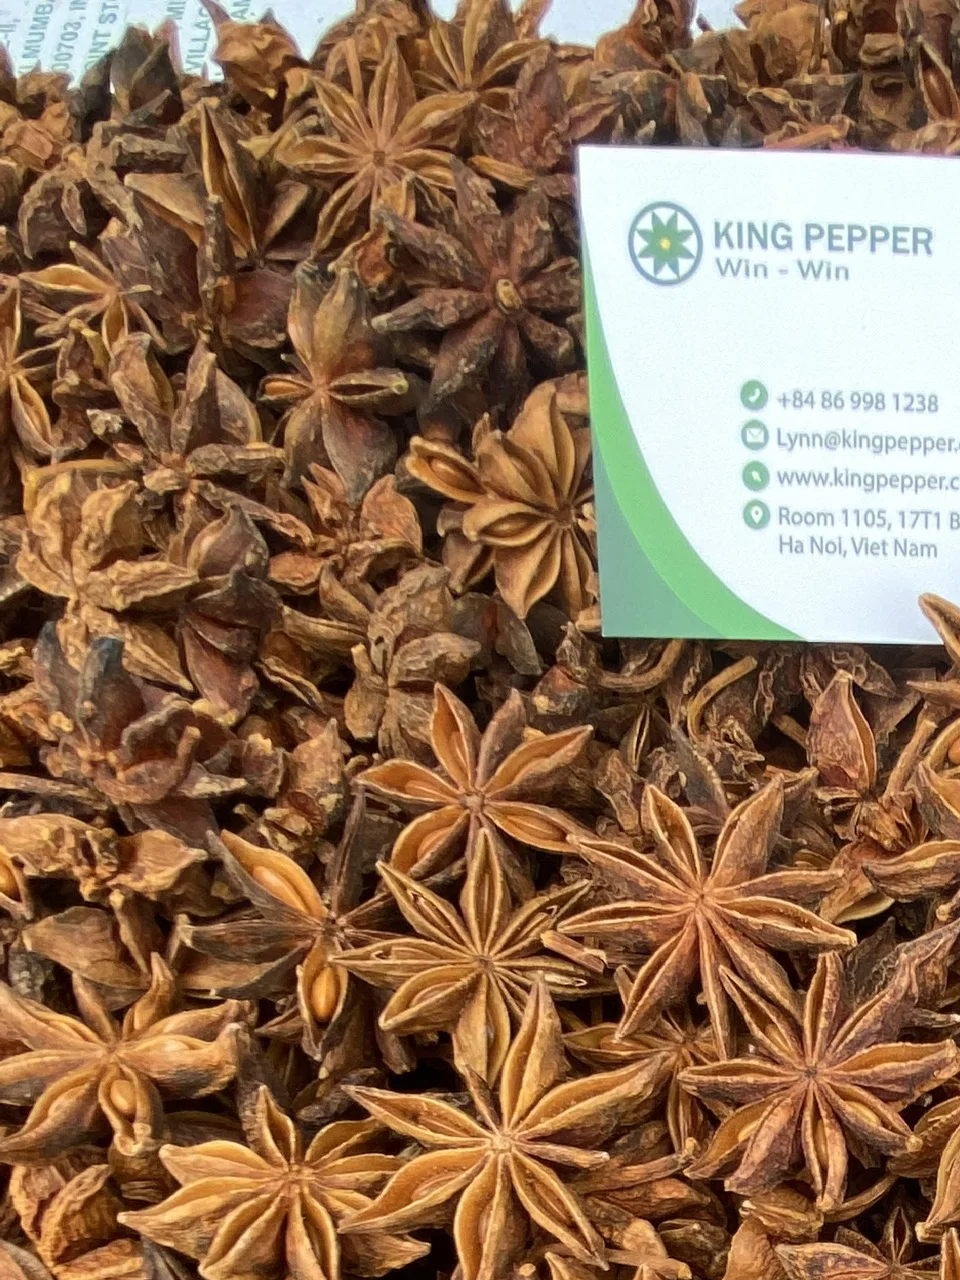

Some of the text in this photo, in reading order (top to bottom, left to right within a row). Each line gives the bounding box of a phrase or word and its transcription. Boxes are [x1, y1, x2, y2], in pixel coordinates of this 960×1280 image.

[98, 0, 119, 24] ST
[22, 0, 56, 59] MUMB
[713, 220, 933, 256] KING PEPPER
[716, 257, 768, 279] Win
[797, 259, 849, 281] Win
[776, 390, 939, 413] +84 86 998 1238
[778, 506, 834, 527] Room
[842, 508, 892, 531] 1105,
[899, 510, 941, 530] 17T1
[779, 535, 938, 558] Ha Noi, Viet Nam
